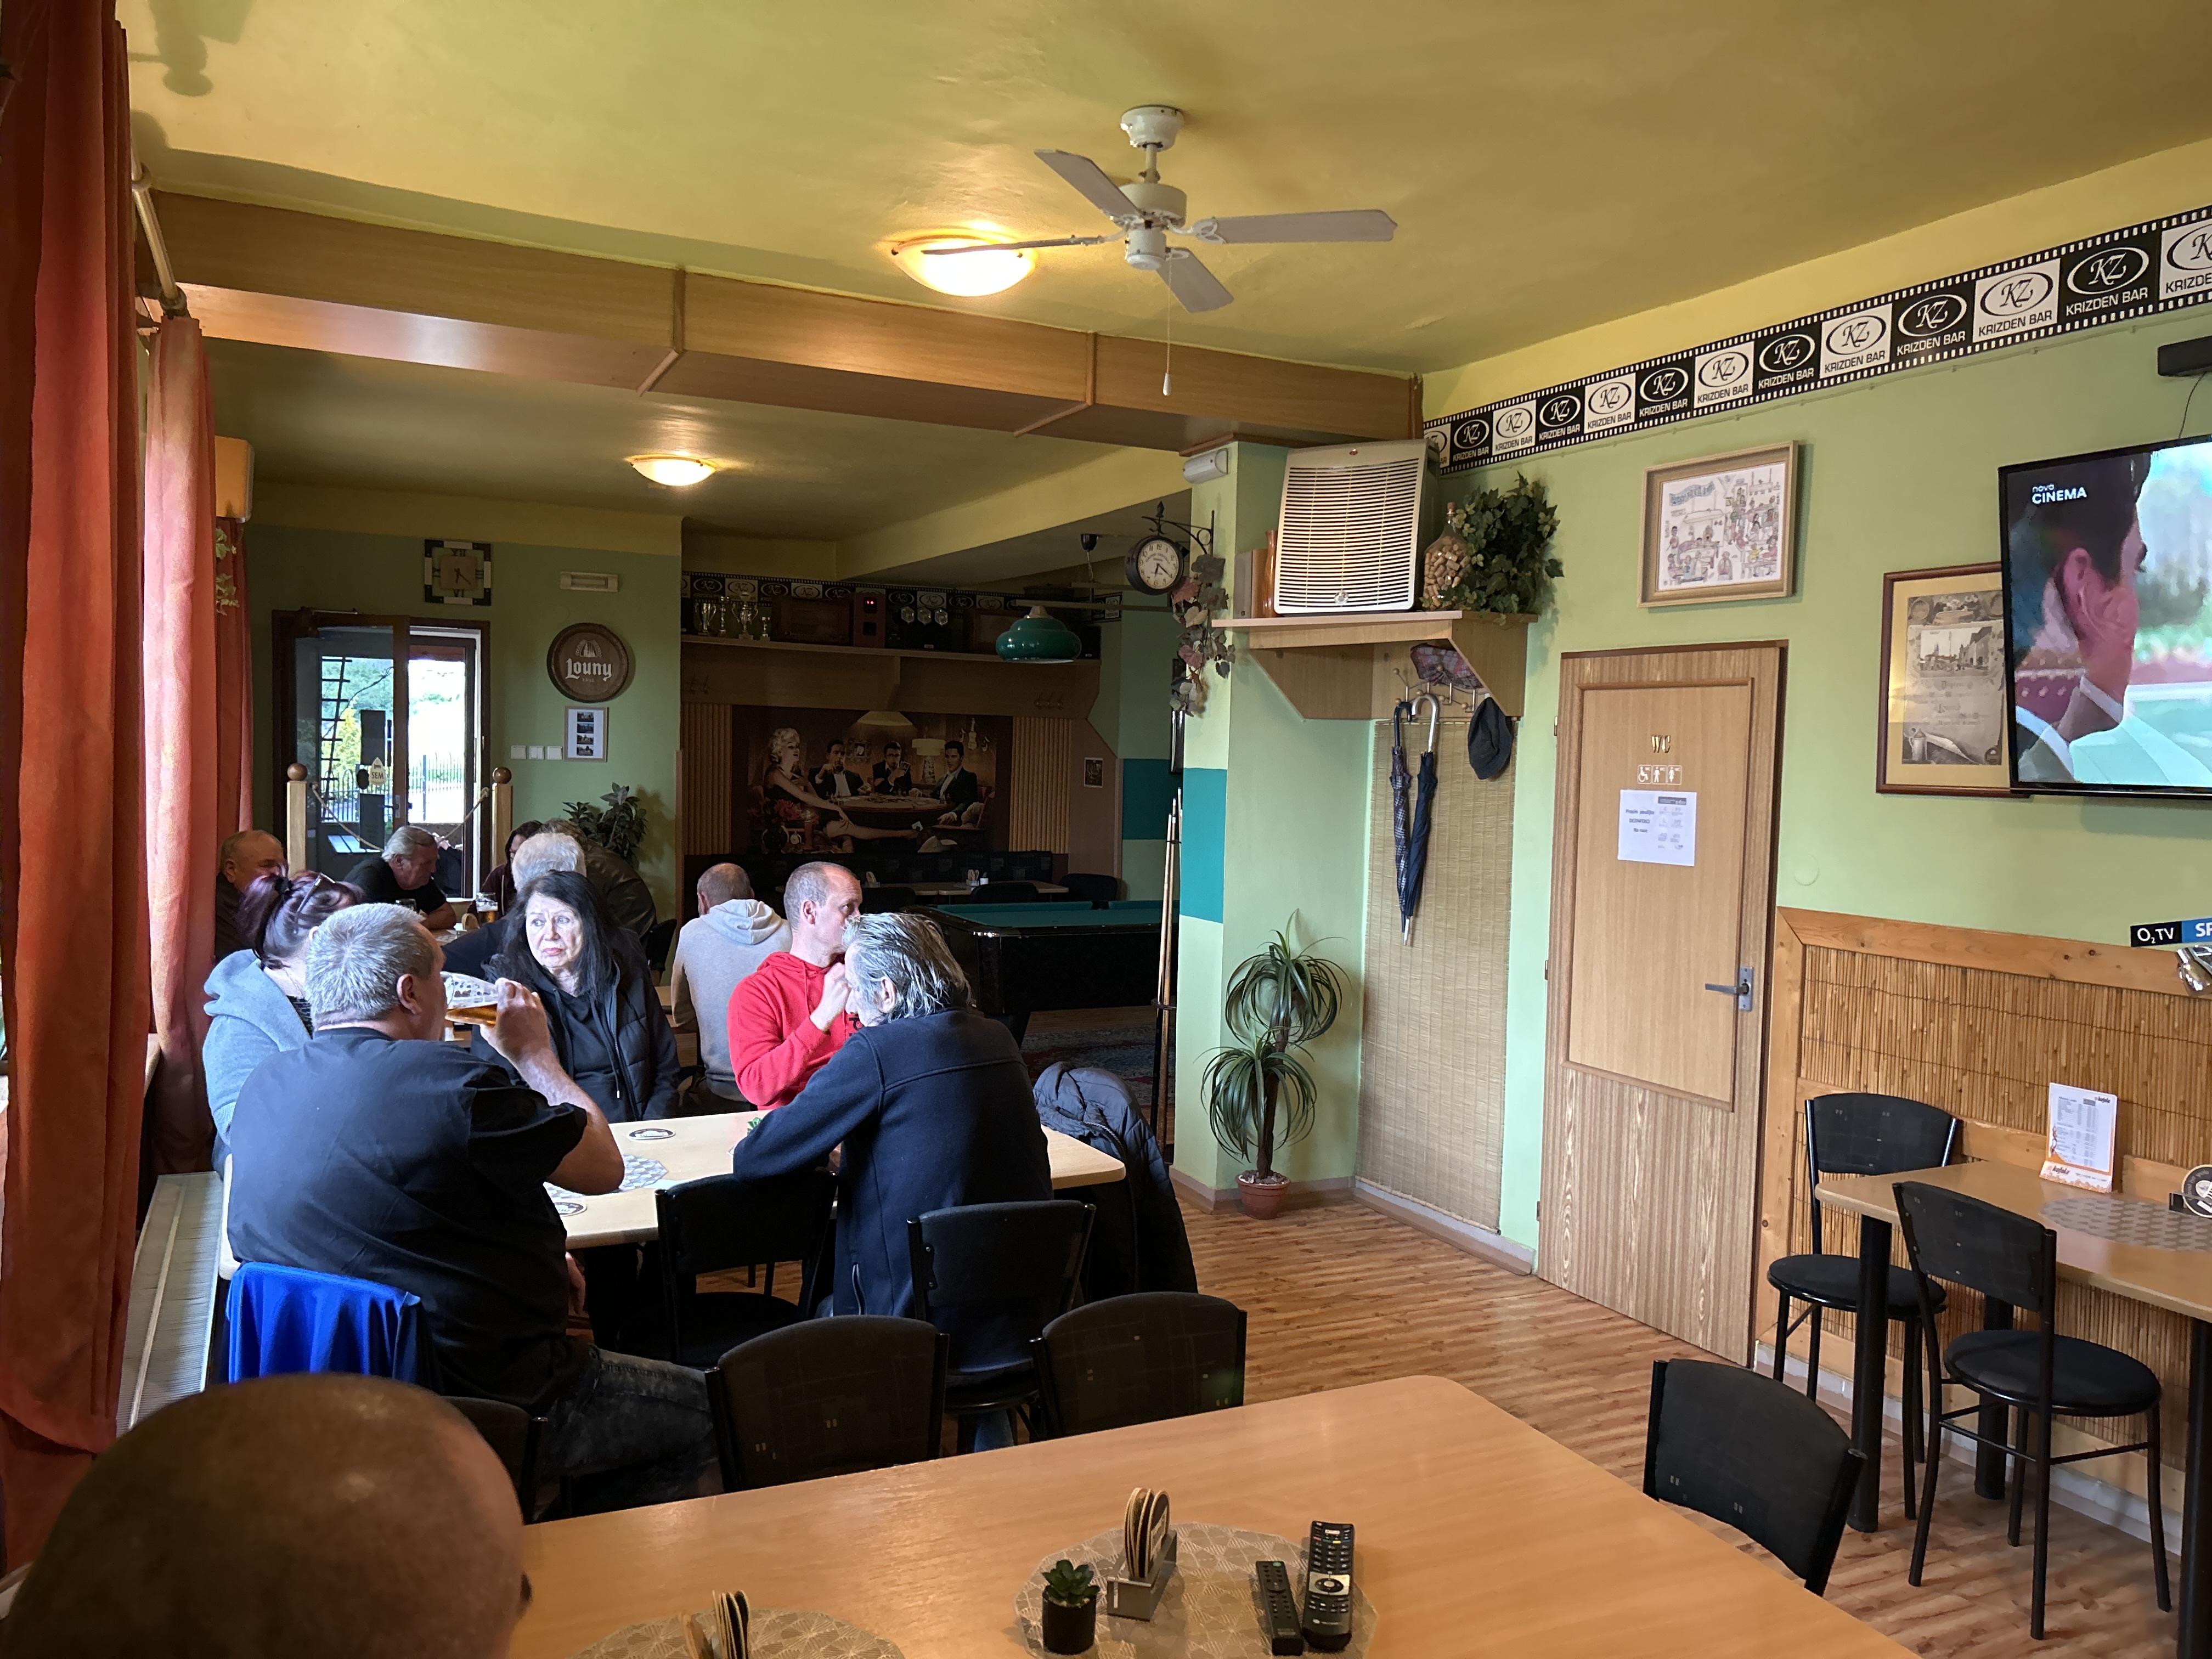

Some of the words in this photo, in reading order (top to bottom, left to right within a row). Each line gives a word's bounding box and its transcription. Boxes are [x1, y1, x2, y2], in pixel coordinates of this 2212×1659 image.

[2190, 233, 2212, 261] K
[2088, 252, 2127, 285] KZ
[2000, 276, 2034, 308] KZ
[2165, 272, 2212, 294] KRIZDE
[2066, 294, 2119, 317] KRIZDEN
[2122, 287, 2148, 304] BAR
[1916, 300, 1948, 329] KZ
[1979, 317, 2026, 337] KRIZDEN
[2029, 310, 2052, 325] BAR
[1842, 320, 1870, 348] KZ
[1897, 336, 1941, 357] KRIZDEN
[1943, 330, 1966, 345] BAR
[1773, 338, 1800, 365] KZ
[1824, 354, 1864, 374] KRIZDEN
[1866, 350, 1886, 364] BAR
[1712, 356, 1735, 381] KZ
[1758, 373, 1794, 390] KRIZDEN
[1796, 367, 1814, 381] BAR
[1652, 372, 1675, 396] KZ
[1697, 388, 1730, 404] KRIZDEN
[1732, 383, 1749, 395] BAR
[1600, 386, 1620, 409] KZ
[1639, 402, 1671, 418] KRIZDEN
[1672, 398, 1688, 410] BAR
[1550, 399, 1571, 422] KZ
[1588, 415, 1616, 430] KRIZDEN
[1617, 411, 1632, 422] BAR
[1463, 423, 1481, 444] KZ
[1505, 412, 1523, 433] KZ
[1539, 428, 1565, 442] KRIZDEN
[1566, 424, 1581, 435] BAR
[1453, 450, 1477, 462] KRIZDEN
[1477, 446, 1489, 456] BAR
[1495, 439, 1519, 452] KRIZDEN
[1521, 435, 1533, 445] BAR
[2032, 483, 2055, 493] nova
[2032, 487, 2087, 504] CINEMA
[566, 658, 612, 681] Louny
[1651, 735, 1671, 753] WC
[2196, 922, 2212, 938] SP
